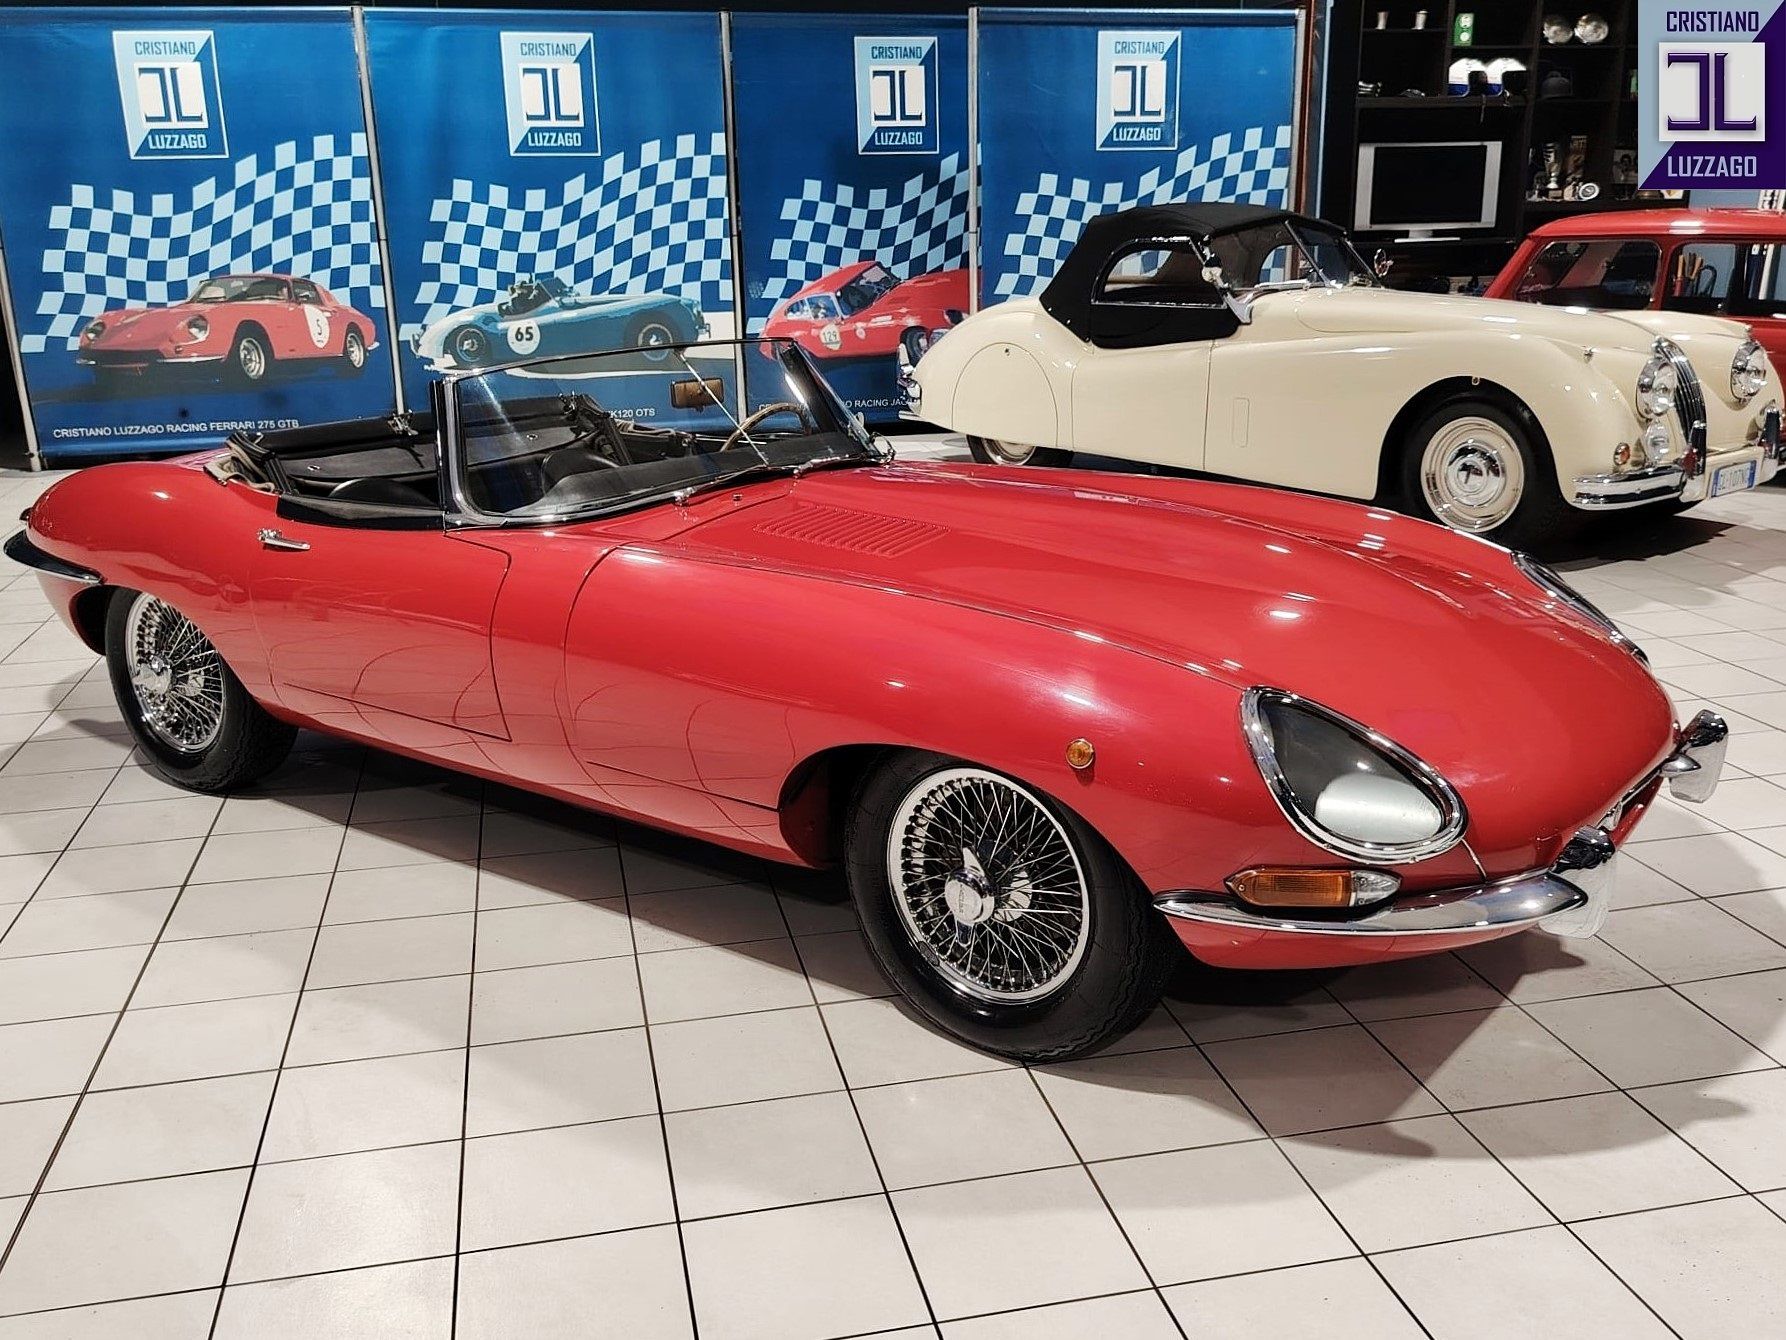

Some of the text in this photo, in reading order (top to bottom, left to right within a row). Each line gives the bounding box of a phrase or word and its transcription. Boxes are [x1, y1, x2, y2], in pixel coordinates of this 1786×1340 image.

[135, 41, 196, 55] CRISTIANO
[520, 42, 576, 56] CRISTIANO
[871, 46, 922, 59] CRISTIANO
[1114, 41, 1165, 54] CRISTIANO
[527, 132, 582, 147] LUZZAGO
[875, 131, 923, 145] LUZZAGO
[1113, 127, 1161, 141] LUZZAGO
[148, 134, 207, 149] LUZZAGO
[316, 319, 323, 336] 5
[515, 326, 534, 342] 65
[854, 399, 889, 408] RACING
[635, 408, 655, 417] OTS
[53, 419, 299, 438] CRISTIANO LUZZAGO RACING FERRARI 275 GTB
